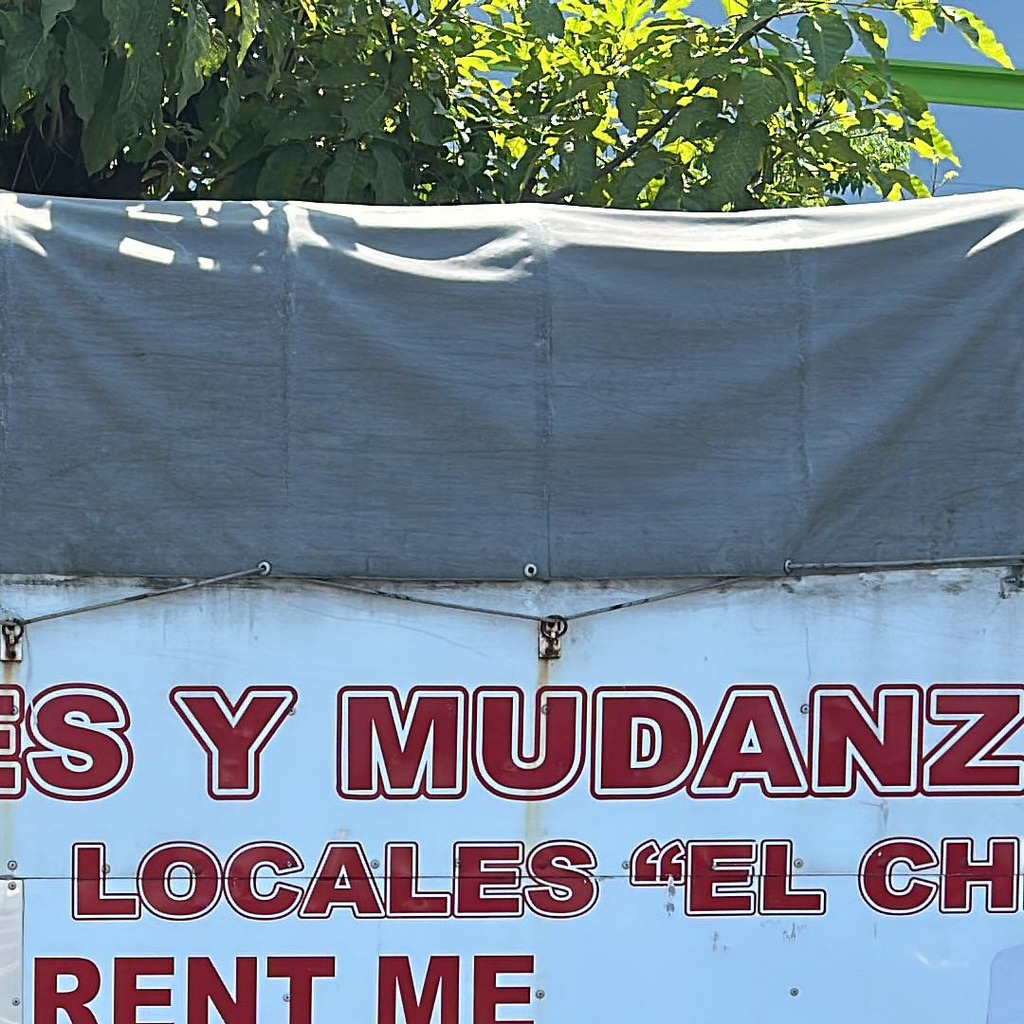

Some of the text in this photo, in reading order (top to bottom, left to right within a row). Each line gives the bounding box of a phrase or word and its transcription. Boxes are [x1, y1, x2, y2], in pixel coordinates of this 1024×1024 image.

[170, 685, 297, 800] Y
[336, 684, 1024, 800] MUDANZ
[72, 839, 600, 921] LOCALES
[858, 836, 1024, 915] CH
